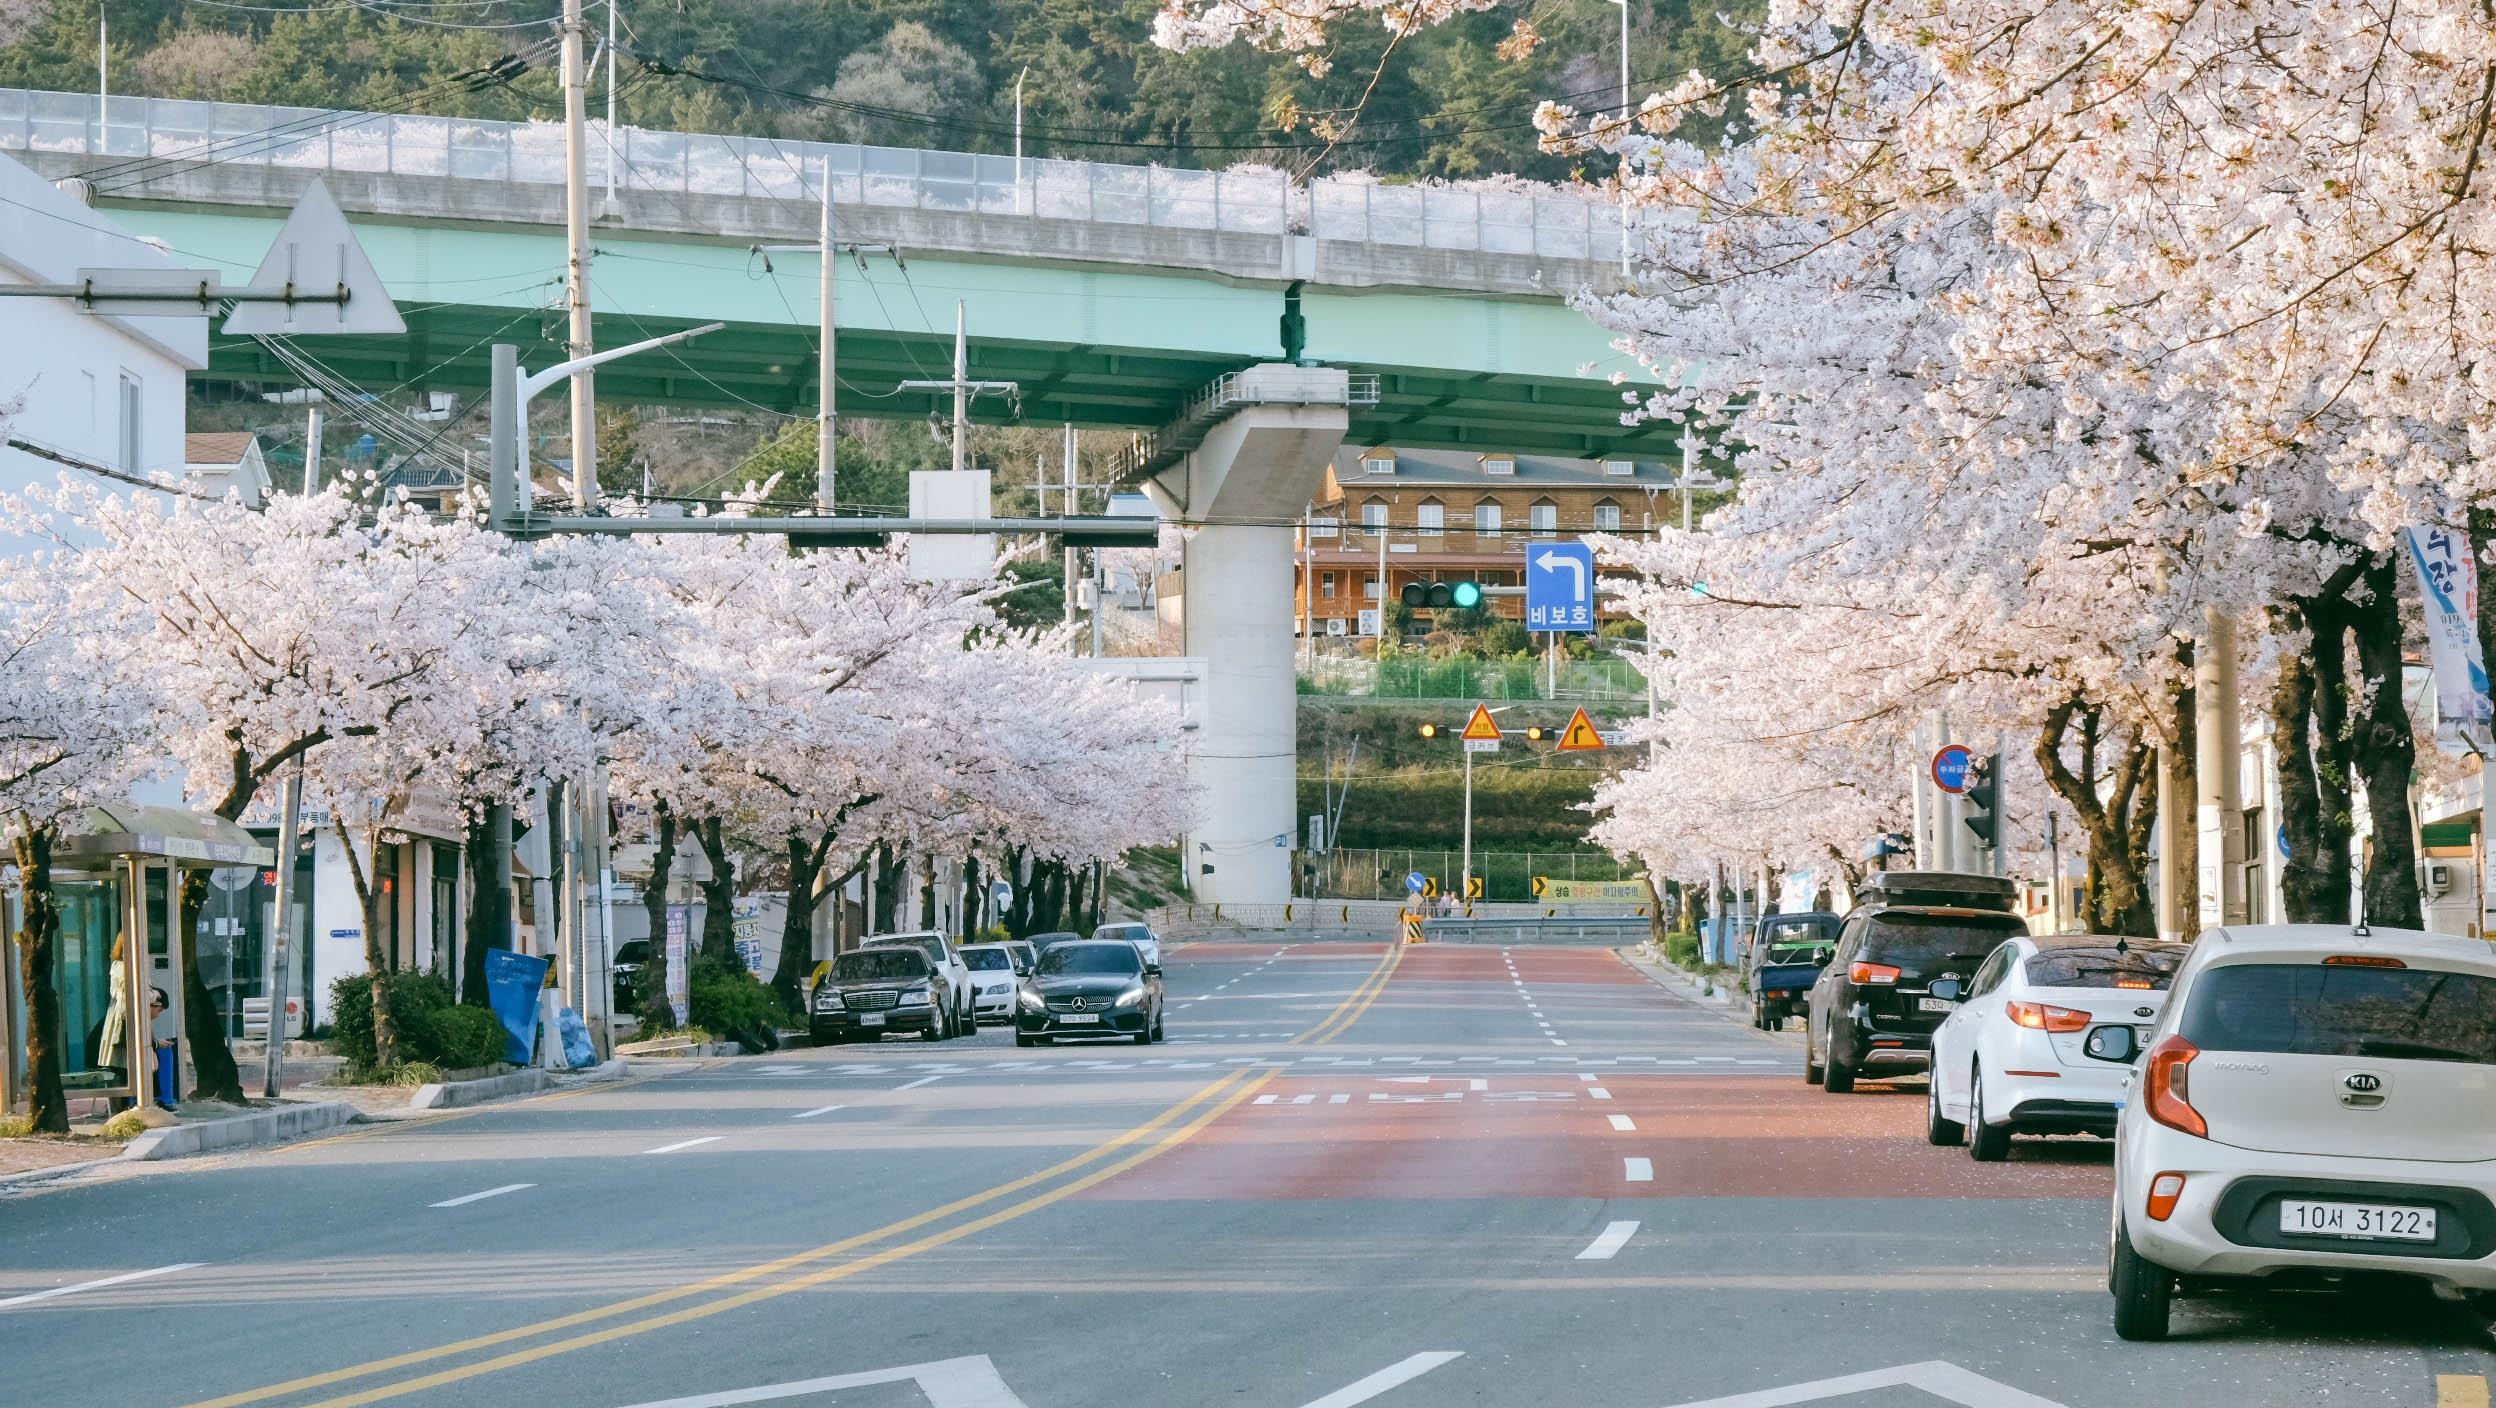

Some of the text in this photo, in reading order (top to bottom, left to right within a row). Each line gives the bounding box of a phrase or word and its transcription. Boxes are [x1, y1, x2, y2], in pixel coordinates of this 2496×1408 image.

[1530, 604, 1589, 626] 비보호
[1940, 765, 1966, 774] 주차금
[1554, 886, 1570, 897] 상습
[2136, 1008, 2152, 1016] KIA
[2214, 1062, 2270, 1075] morning
[2351, 1076, 2377, 1089] KIA
[2297, 1205, 2421, 1234] 10서 3122
